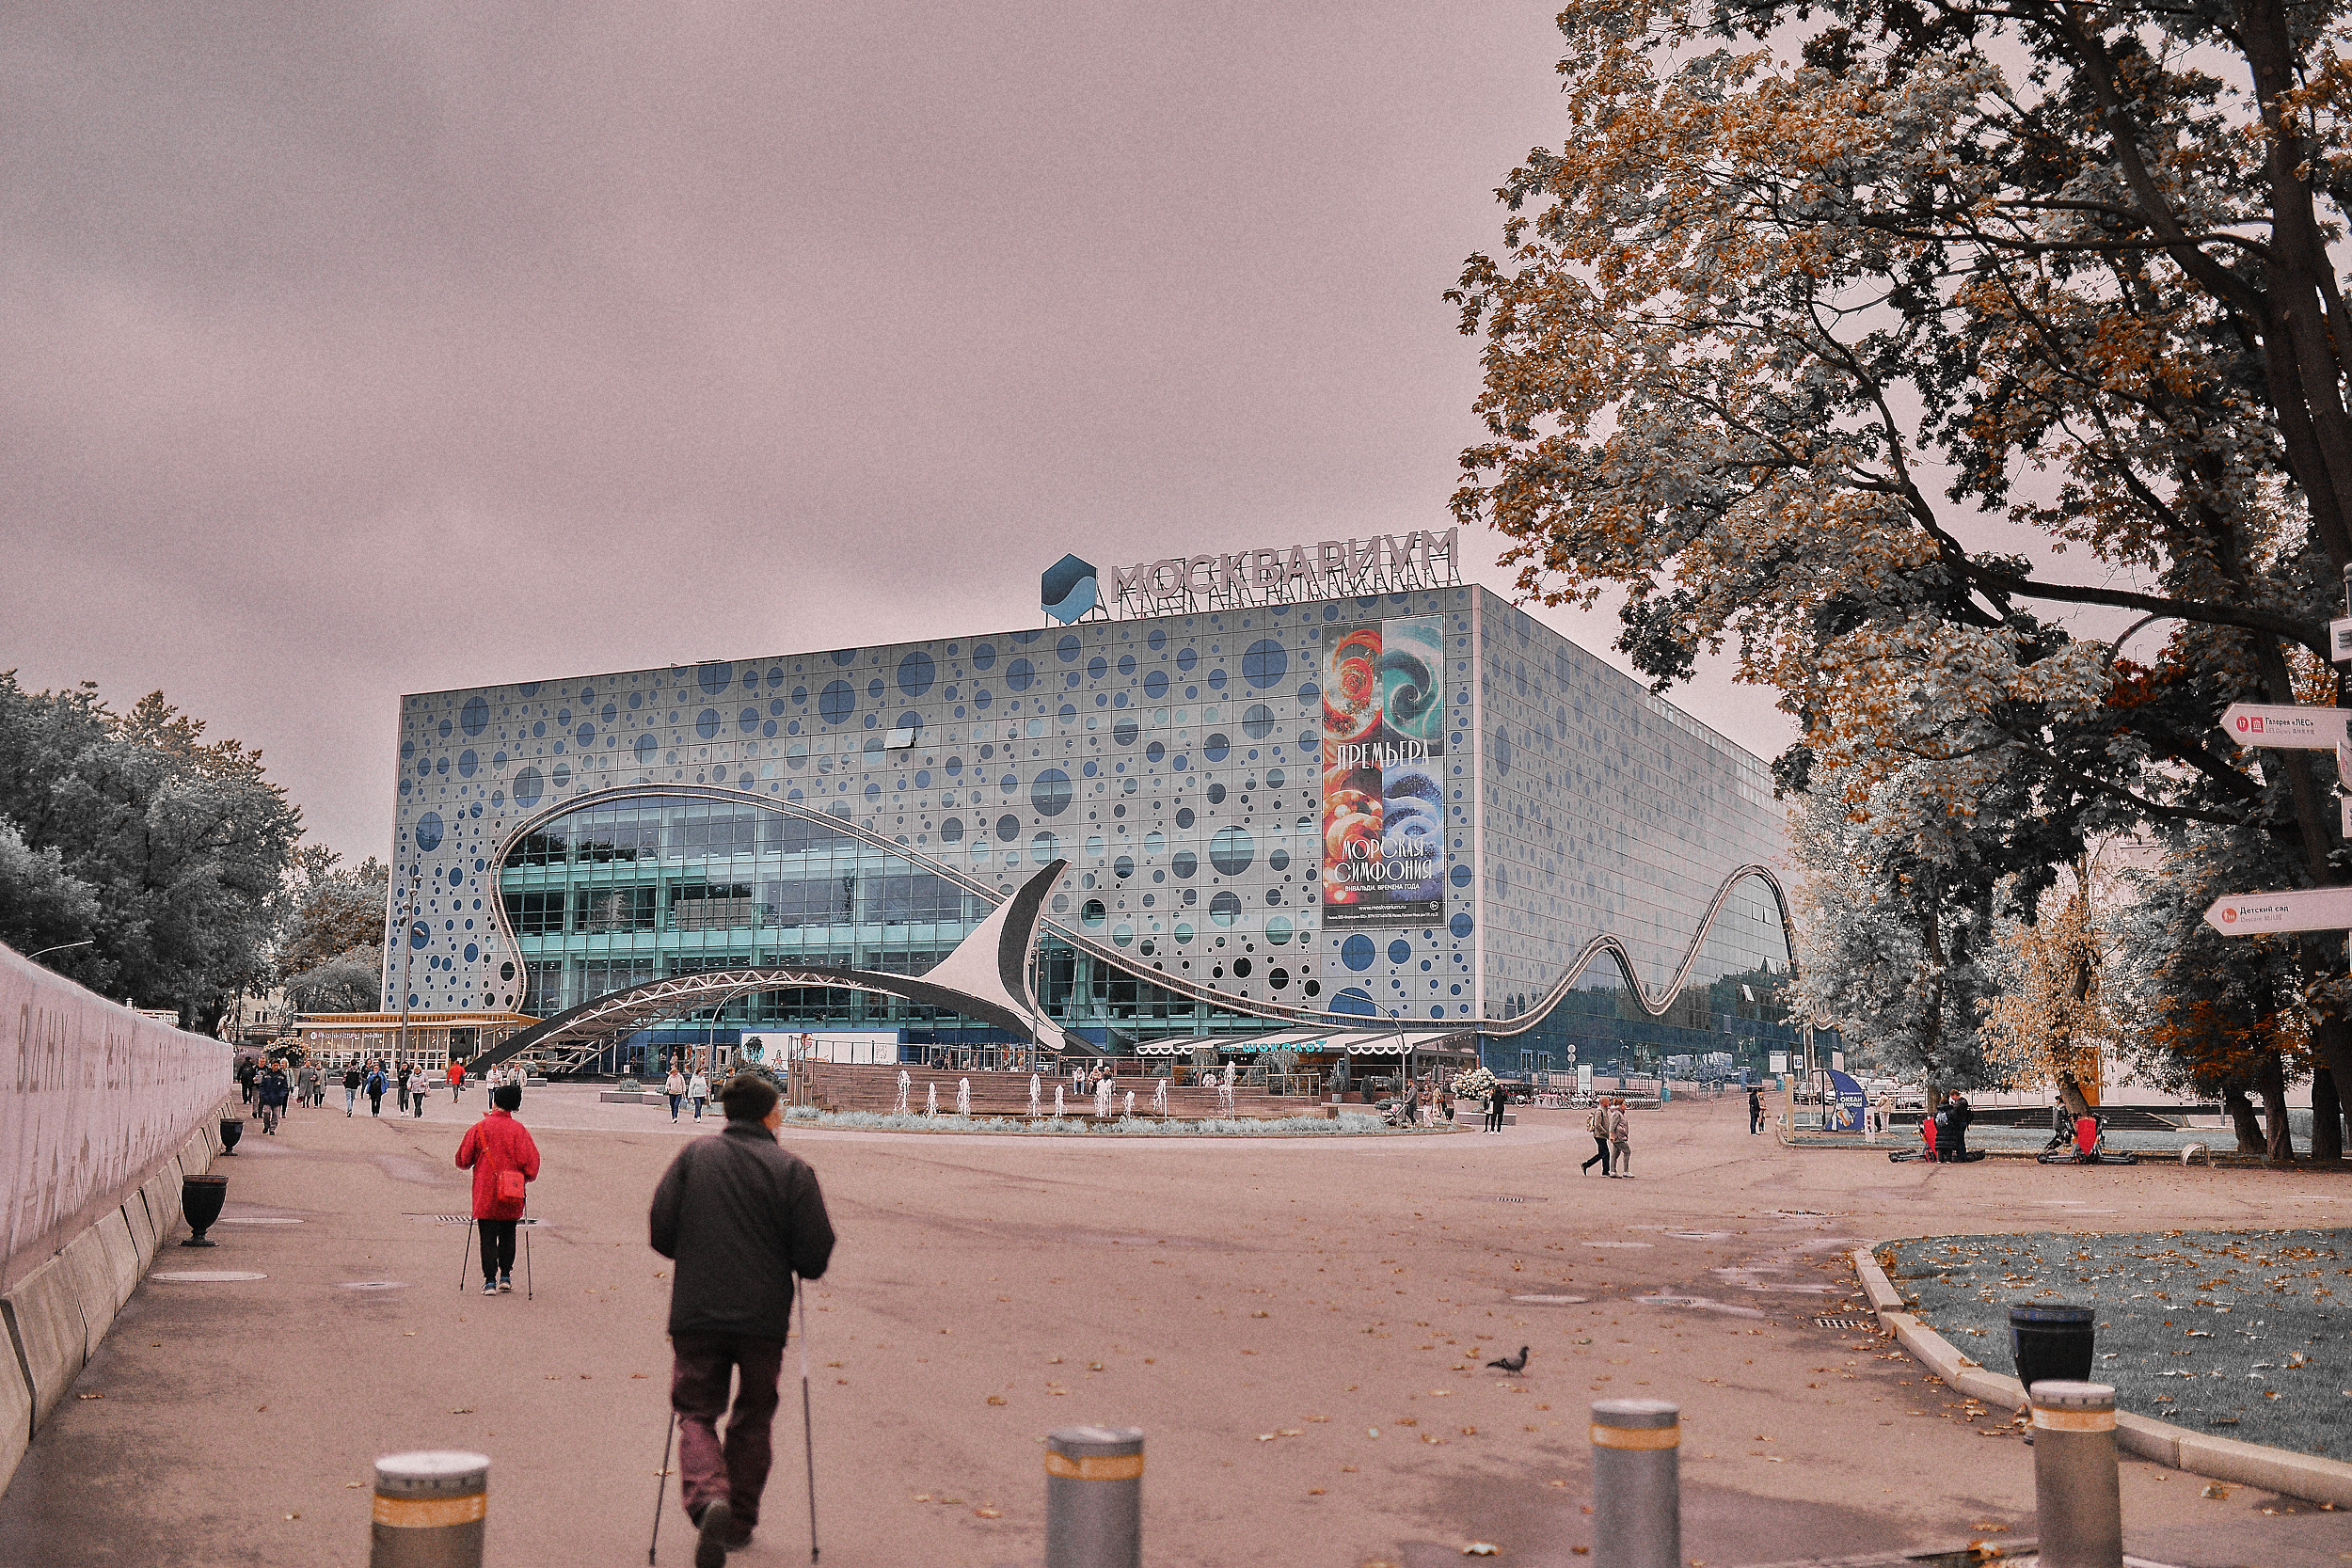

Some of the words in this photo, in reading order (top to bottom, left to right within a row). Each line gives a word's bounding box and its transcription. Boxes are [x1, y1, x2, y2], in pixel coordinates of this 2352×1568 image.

[1110, 527, 1459, 603] МОСКВАРИУМ
[2265, 717, 2290, 726] Галерея
[2291, 718, 2314, 727] «ЛЕС»
[1337, 738, 1430, 770] ПРЕМЬЕРА
[1342, 835, 1424, 860] МОРСКАЯ
[1334, 858, 1433, 883] СИМФОНИЯ
[2239, 906, 2273, 915] Детский
[16, 1002, 69, 1093] ВДНХ
